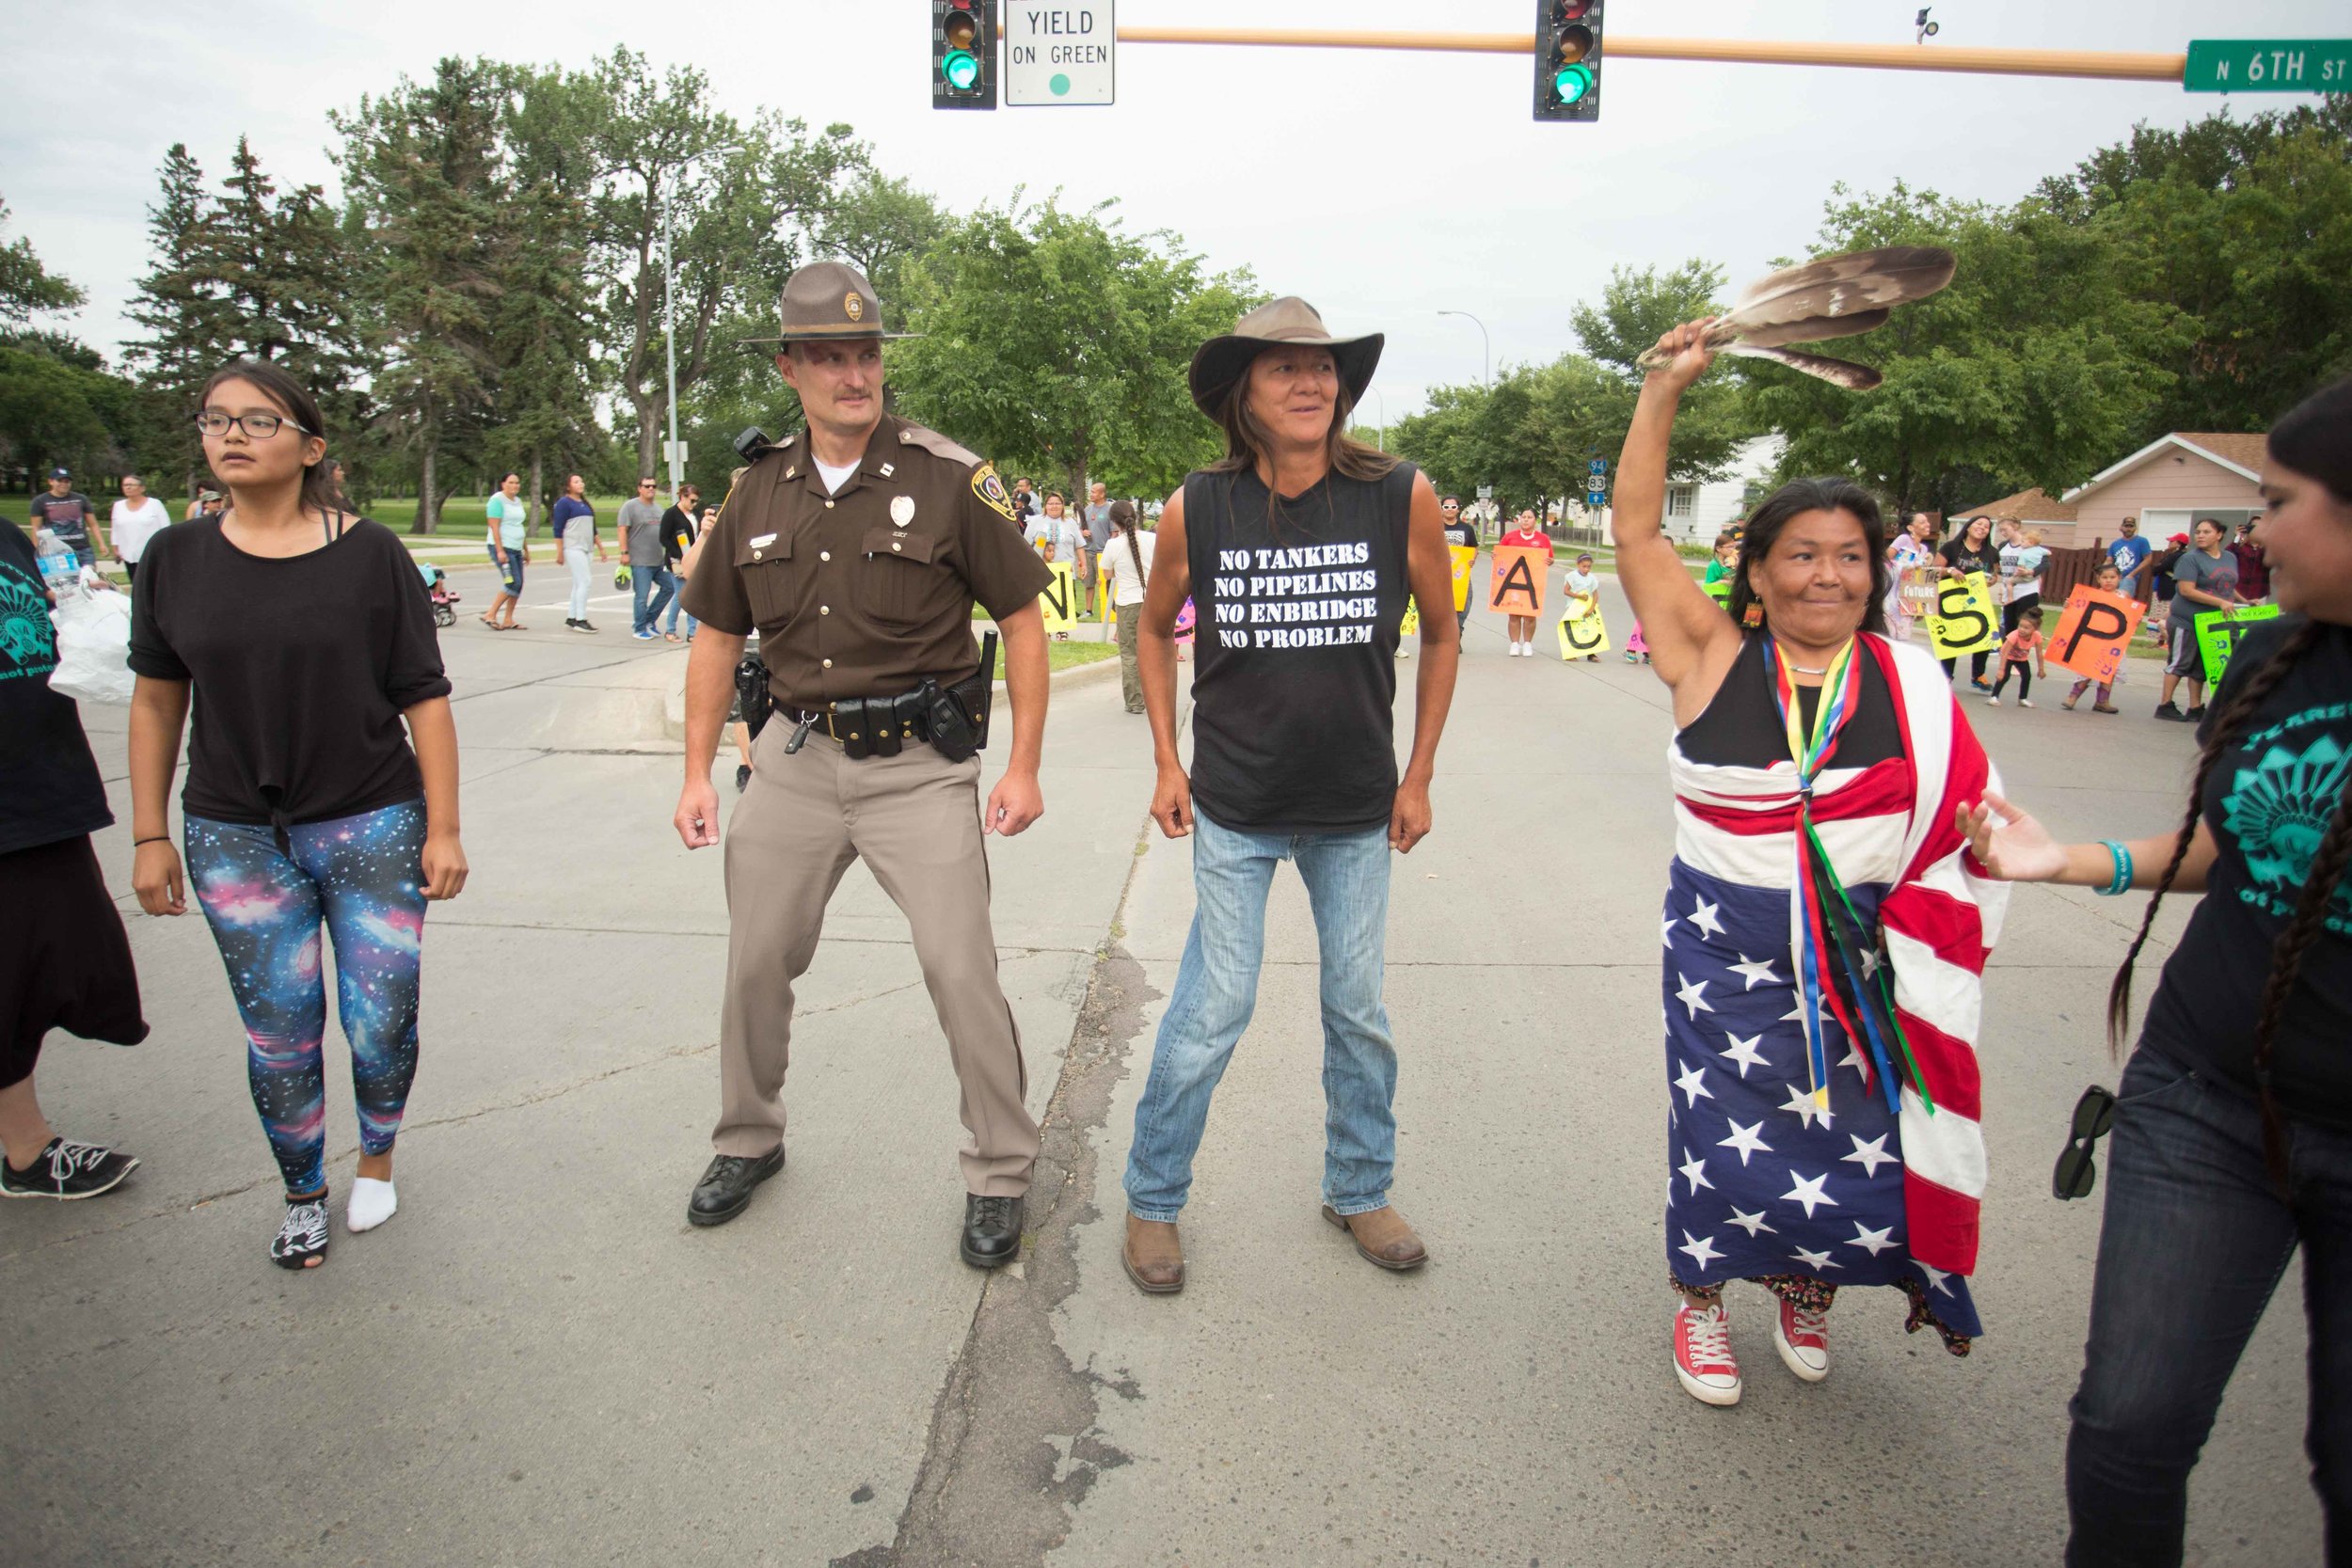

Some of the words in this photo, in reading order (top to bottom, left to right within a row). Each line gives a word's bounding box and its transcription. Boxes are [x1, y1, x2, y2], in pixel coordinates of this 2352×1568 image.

[1027, 11, 1093, 35] YIELD
[1013, 46, 1036, 64] ON
[1051, 45, 1106, 63] GREEN
[2216, 59, 2230, 81] N
[2248, 51, 2304, 81] 6TH
[2321, 59, 2347, 81] ST
[1591, 460, 1604, 471] 94
[1589, 478, 1604, 488] 83
[1219, 549, 1250, 571] NO
[1255, 542, 1370, 570] TANKERS
[1214, 577, 1245, 597] NO
[1249, 570, 1376, 596] PIPELINES
[1493, 555, 1539, 610] A
[1903, 585, 1935, 598] FUTURE
[1215, 604, 1245, 624] NO
[1249, 597, 1377, 623] ENBRIDGE
[1938, 587, 1990, 648] S
[1218, 629, 1248, 648] NO
[1254, 625, 1374, 648] PROBLEM
[2061, 600, 2128, 664] P
